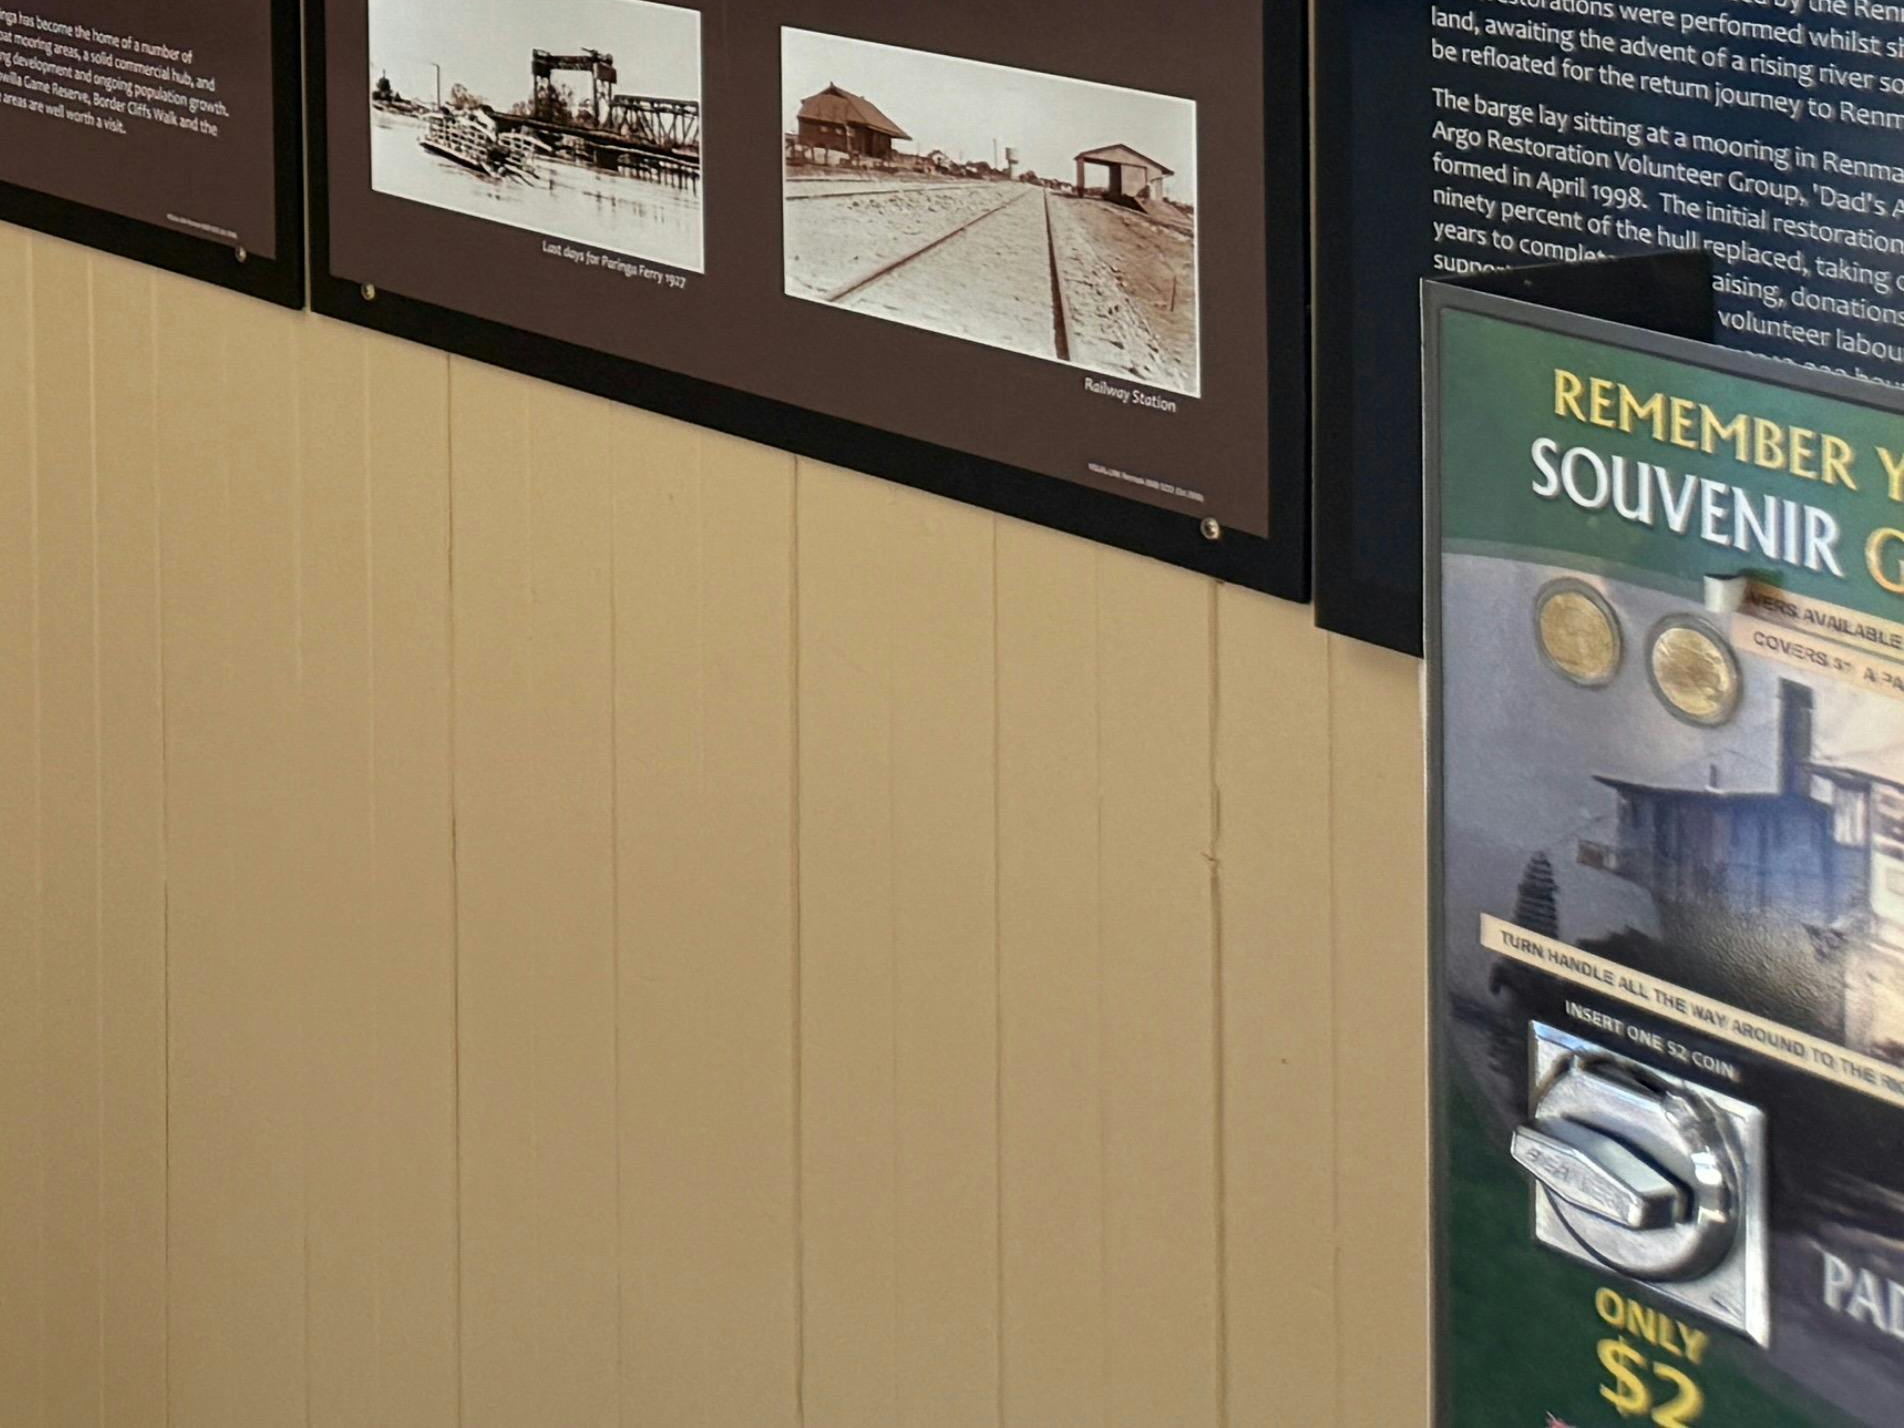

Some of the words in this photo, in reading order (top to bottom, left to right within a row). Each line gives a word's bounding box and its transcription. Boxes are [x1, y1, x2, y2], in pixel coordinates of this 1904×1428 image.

[542, 240, 562, 257] Last
[562, 246, 585, 263] days
[585, 250, 600, 265] for
[601, 254, 638, 278] Paringa
[638, 264, 664, 285] Ferry
[664, 273, 687, 289] 1927
[1084, 377, 1131, 404] Railway
[1132, 389, 1177, 413] Station
[1553, 368, 1858, 491] REMEMBER
[1530, 436, 1846, 580] SOUVENIR
[1753, 630, 1829, 667] COVERS
[1803, 609, 1903, 650] AVAILABLE
[1500, 930, 1545, 958] TURN
[1546, 947, 1615, 986] HANDLE
[1618, 976, 1649, 999] ALL
[1653, 988, 1687, 1014] THE
[1693, 1004, 1727, 1027] WAY
[1732, 1019, 1807, 1057] AROUND
[1811, 1046, 1834, 1068] TO
[1840, 1056, 1876, 1084] THE
[1565, 1000, 1625, 1036] INSERT
[1626, 1025, 1665, 1051] ONE
[1692, 1050, 1736, 1081] COIN
[1595, 1286, 1709, 1366] ONLY
[1597, 1334, 1704, 1428] $2
